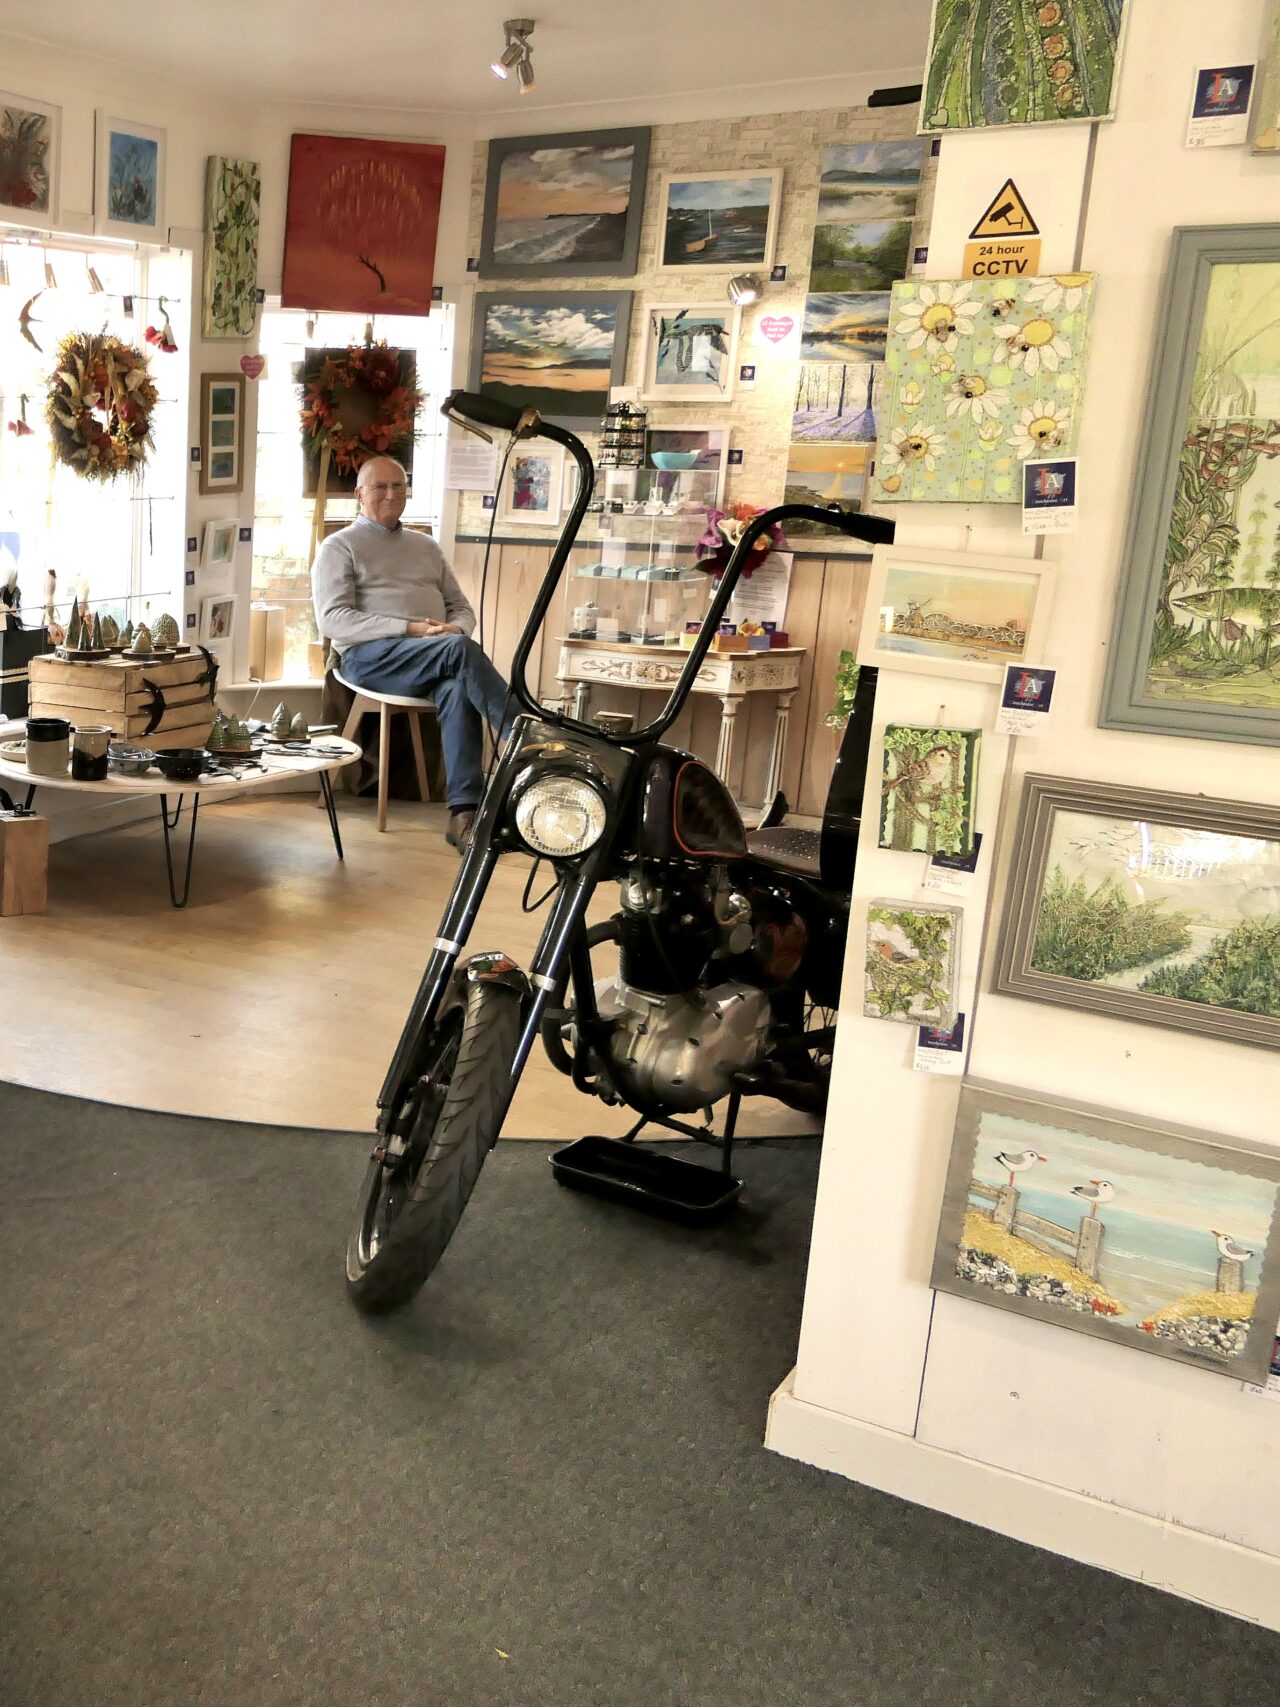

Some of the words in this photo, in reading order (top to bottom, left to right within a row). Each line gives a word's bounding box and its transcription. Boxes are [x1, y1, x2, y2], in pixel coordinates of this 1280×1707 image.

[979, 246, 993, 256] 24
[996, 245, 1025, 255] hour
[972, 259, 1028, 277] CCTV
